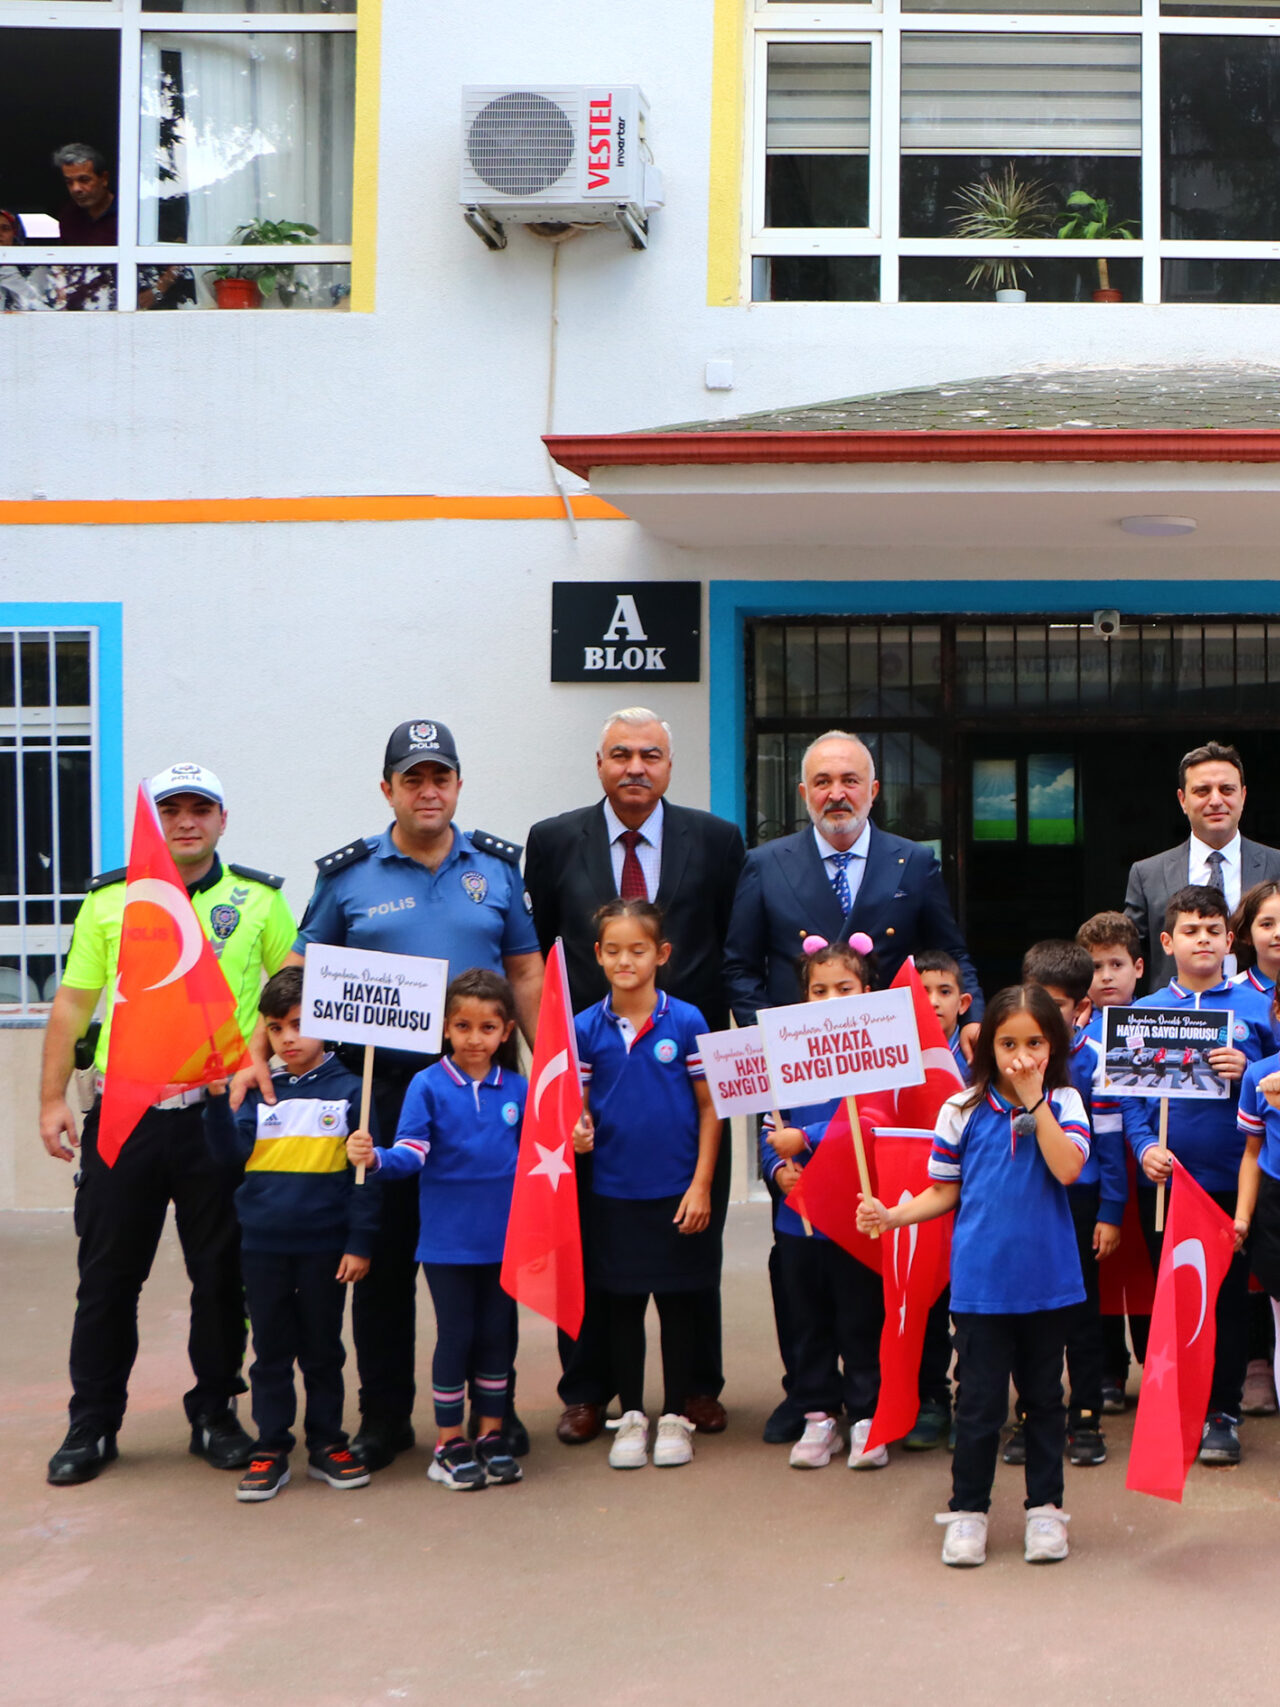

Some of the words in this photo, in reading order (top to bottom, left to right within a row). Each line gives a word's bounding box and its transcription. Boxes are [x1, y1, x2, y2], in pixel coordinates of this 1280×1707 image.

[588, 92, 612, 190] VESTEL
[616, 116, 626, 168] inverter
[603, 594, 648, 641] A
[583, 646, 667, 670] BLOK
[368, 897, 417, 918] POLİS
[343, 981, 401, 1007] HAYATA
[313, 999, 360, 1023] SAYGI
[363, 1005, 431, 1032] DURUŞU
[807, 1028, 874, 1058] HAYATA
[1116, 1024, 1150, 1038] HAYATA
[1151, 1025, 1179, 1039] SAYGI
[1180, 1026, 1219, 1042] DURUŞU
[735, 1054, 767, 1077] HAYA
[780, 1057, 832, 1084] SAYGI
[835, 1043, 910, 1076] DURUŞU
[718, 1078, 757, 1099] SAYGI
